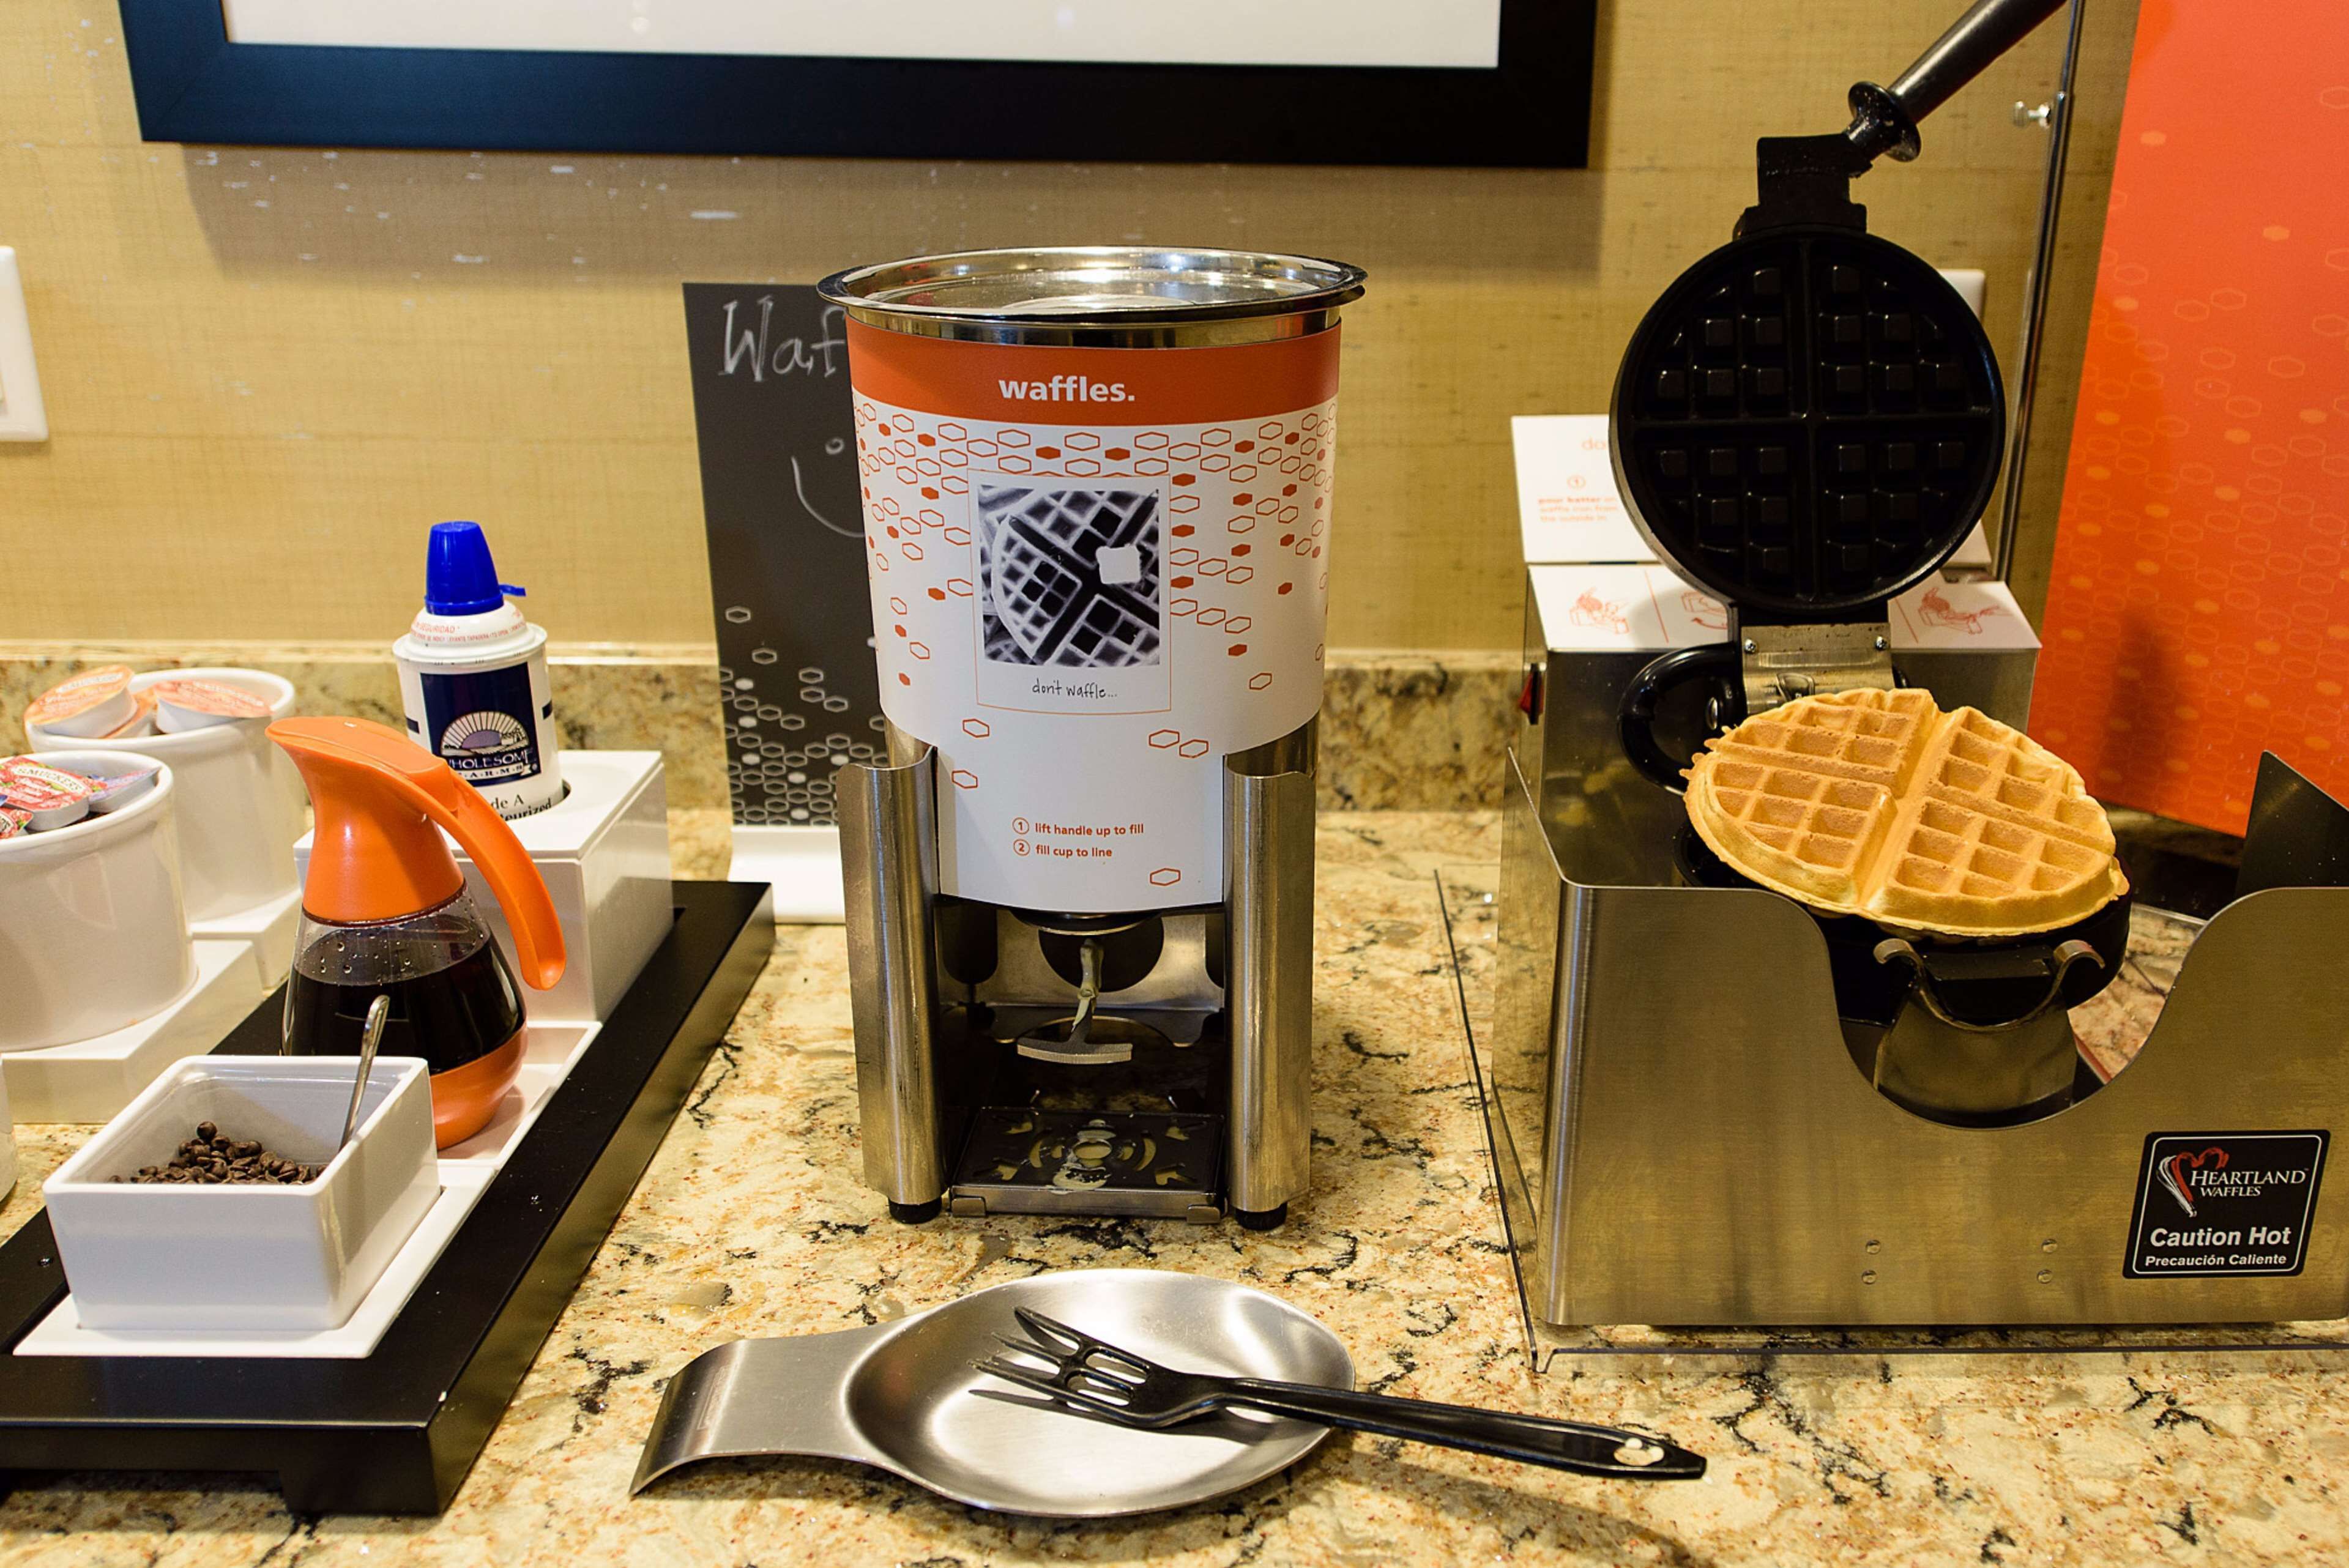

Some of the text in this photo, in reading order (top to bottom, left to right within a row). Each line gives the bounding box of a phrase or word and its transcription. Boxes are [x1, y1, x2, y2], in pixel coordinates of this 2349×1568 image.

[998, 375, 1135, 402] waffles.
[1032, 677, 1062, 696] don't
[514, 794, 524, 807] A
[1035, 823, 1051, 834] lift
[1054, 824, 1093, 836] handle
[1096, 827, 1111, 838] up
[1114, 825, 1126, 835] to
[1129, 823, 1144, 834] fill
[1035, 844, 1050, 855] fill
[1053, 848, 1073, 858] cup
[1076, 847, 1089, 857] to
[1092, 847, 1113, 857] line
[2190, 1170, 2306, 1186] HEARTLAND
[2200, 1186, 2262, 1197] WAFFLES
[2150, 1226, 2292, 1247] Caution Hot
[2145, 1253, 2287, 1267] Precaución Caliente
